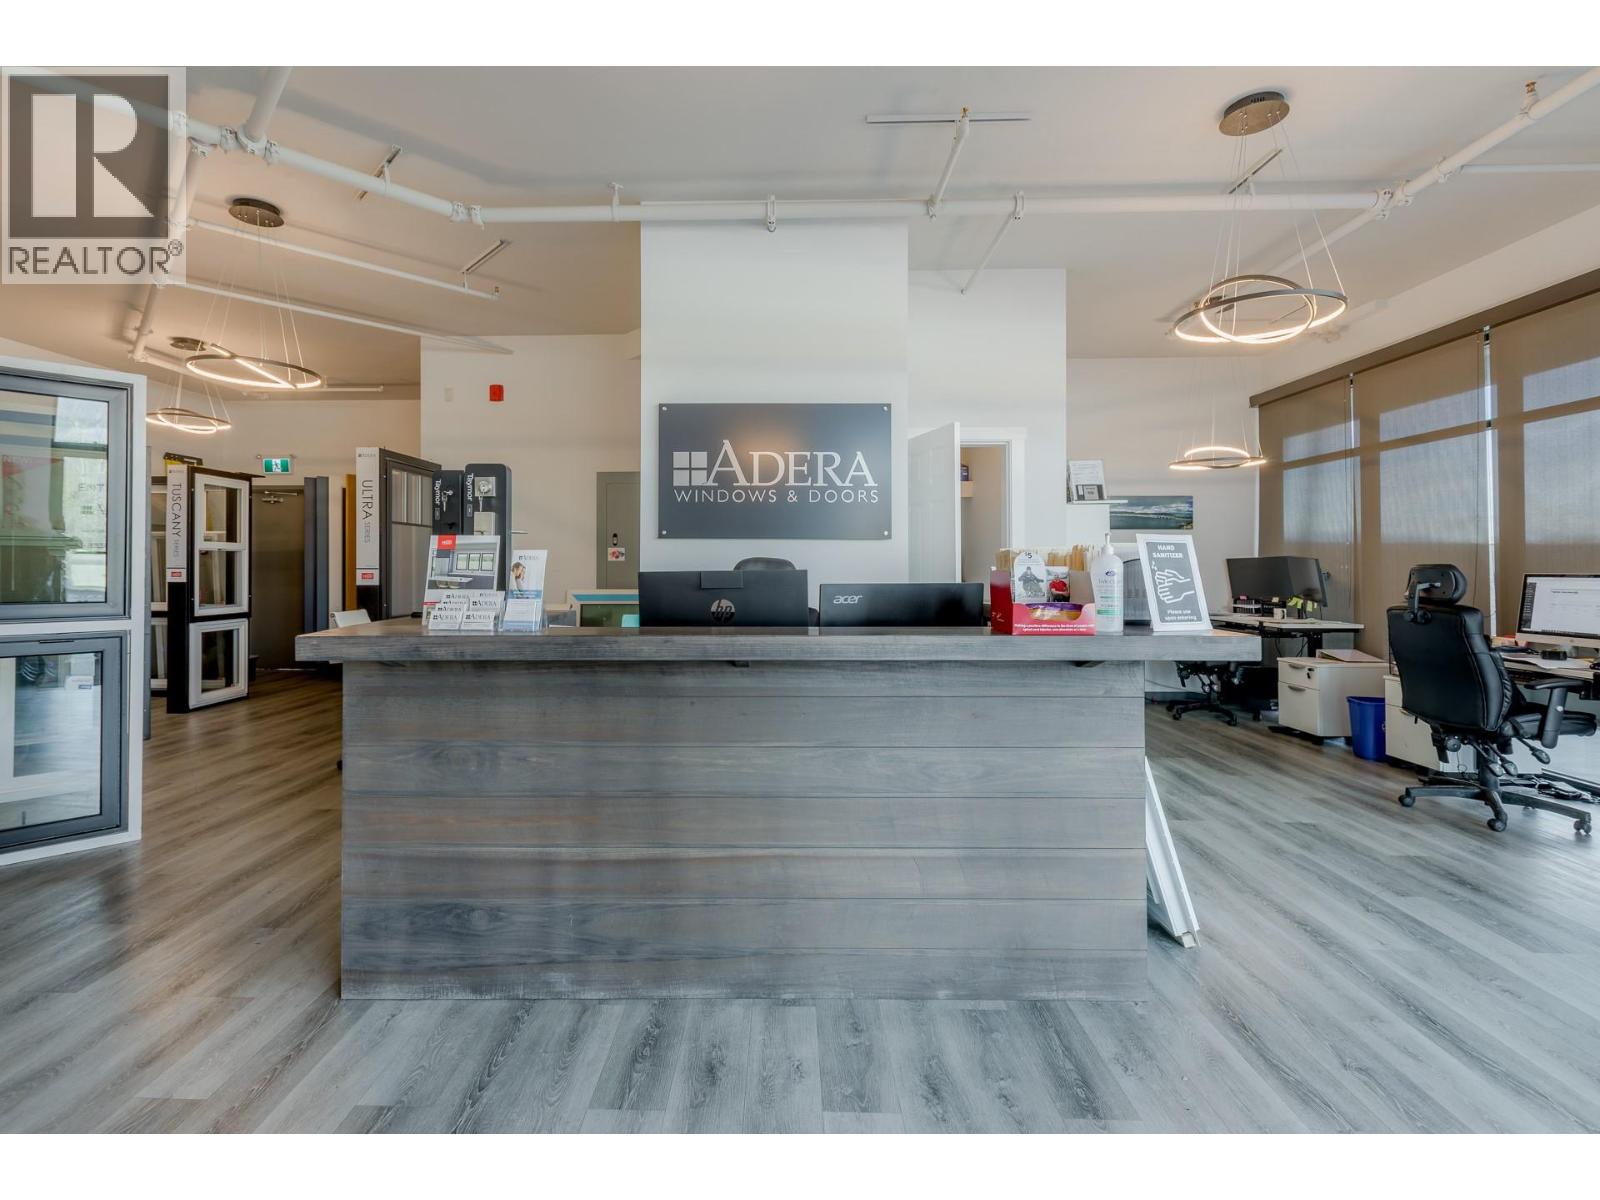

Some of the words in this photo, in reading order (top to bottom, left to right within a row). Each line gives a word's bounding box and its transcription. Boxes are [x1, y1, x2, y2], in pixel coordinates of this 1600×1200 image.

[702, 439, 879, 487] ADERA
[361, 480, 374, 520] ULTRA
[434, 478, 442, 506] Taymor
[465, 473, 474, 501] Taymor
[673, 489, 777, 503] WINDOWS
[787, 489, 798, 503] &
[809, 489, 879, 503] DOORS
[171, 484, 182, 537] TUSCANY
[711, 599, 735, 626] hp
[833, 595, 863, 604] acer
